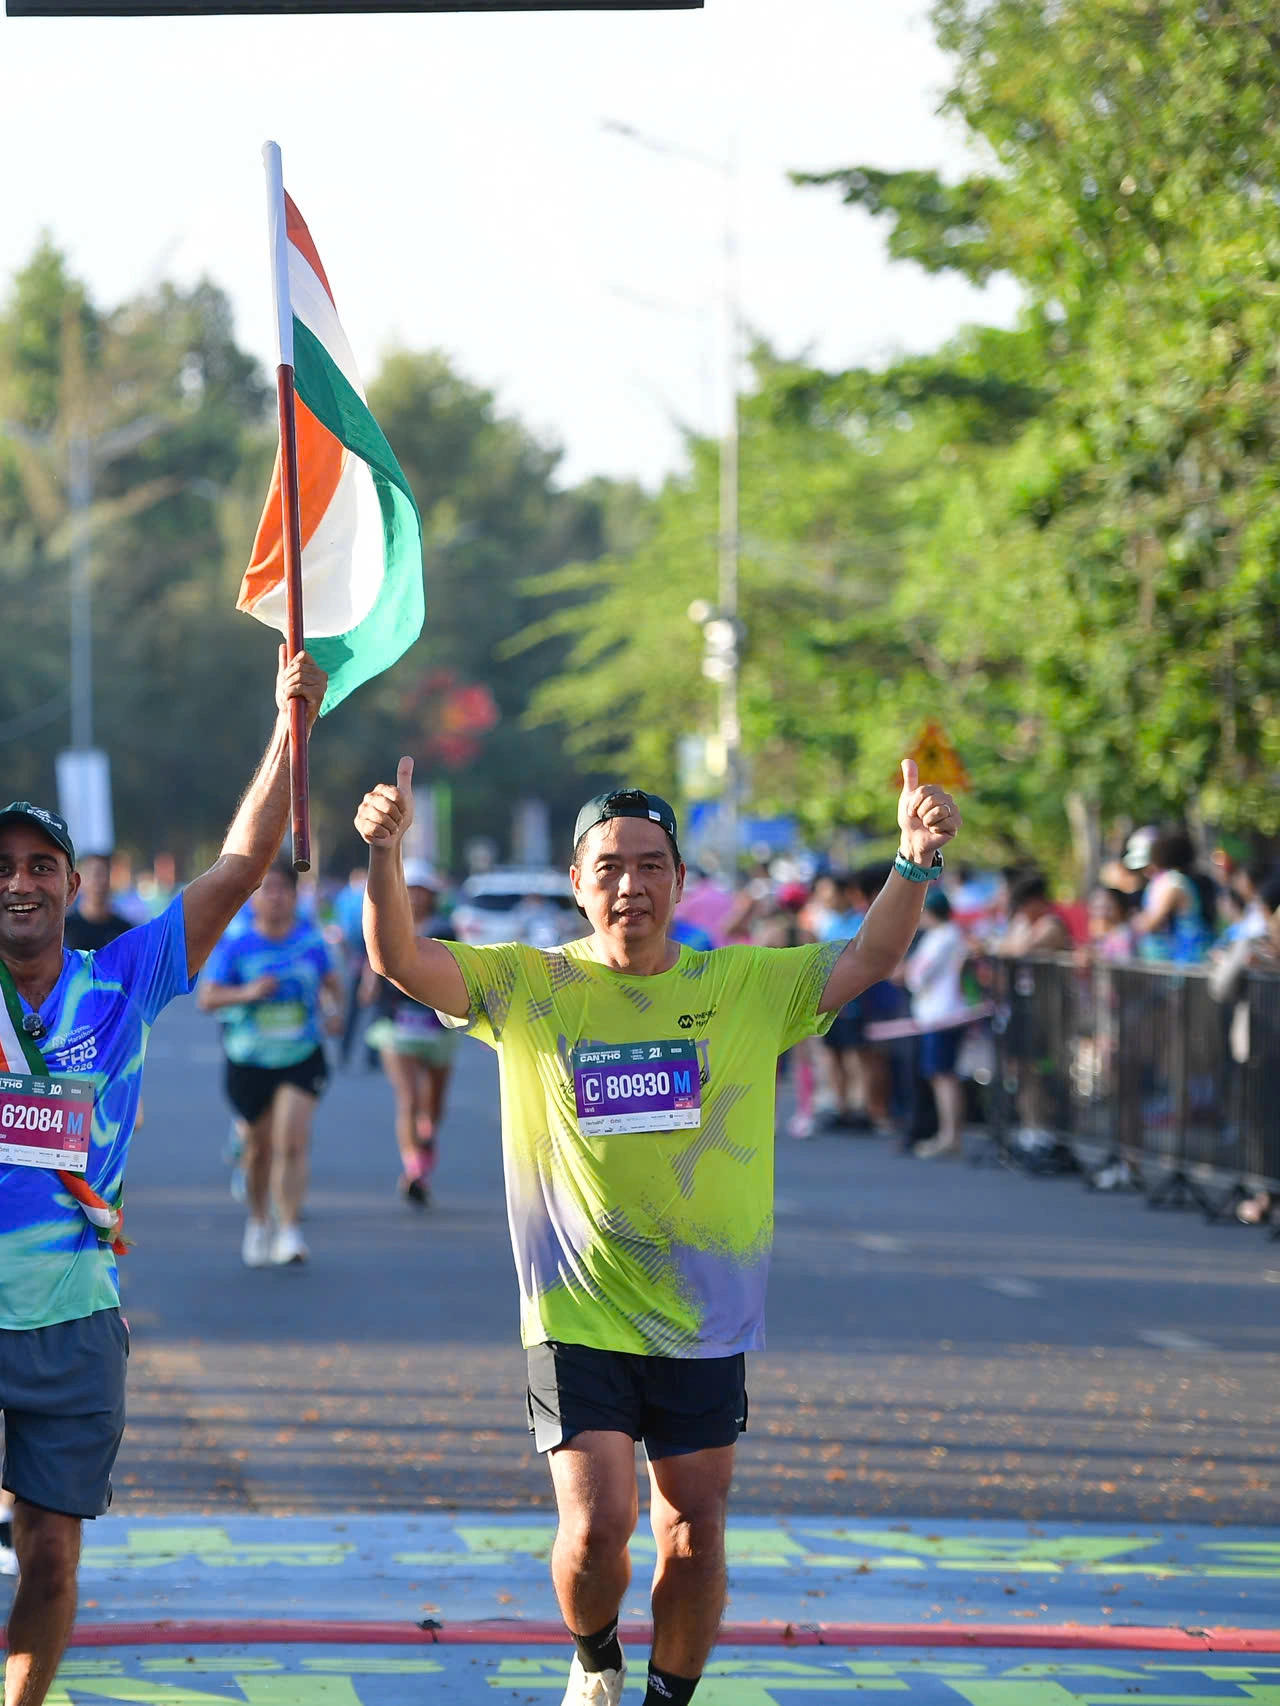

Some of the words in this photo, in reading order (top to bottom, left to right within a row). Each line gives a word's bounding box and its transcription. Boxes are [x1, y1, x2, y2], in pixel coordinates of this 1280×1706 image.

[56, 1046, 98, 1067] THO
[580, 1054, 600, 1062] CAN
[66, 1061, 93, 1073] 2026
[3, 1081, 23, 1089] THO
[585, 1078, 600, 1102] C
[606, 1071, 670, 1100] 80930
[673, 1070, 691, 1094] M
[1, 1104, 64, 1133] 62084
[66, 1111, 84, 1135] M
